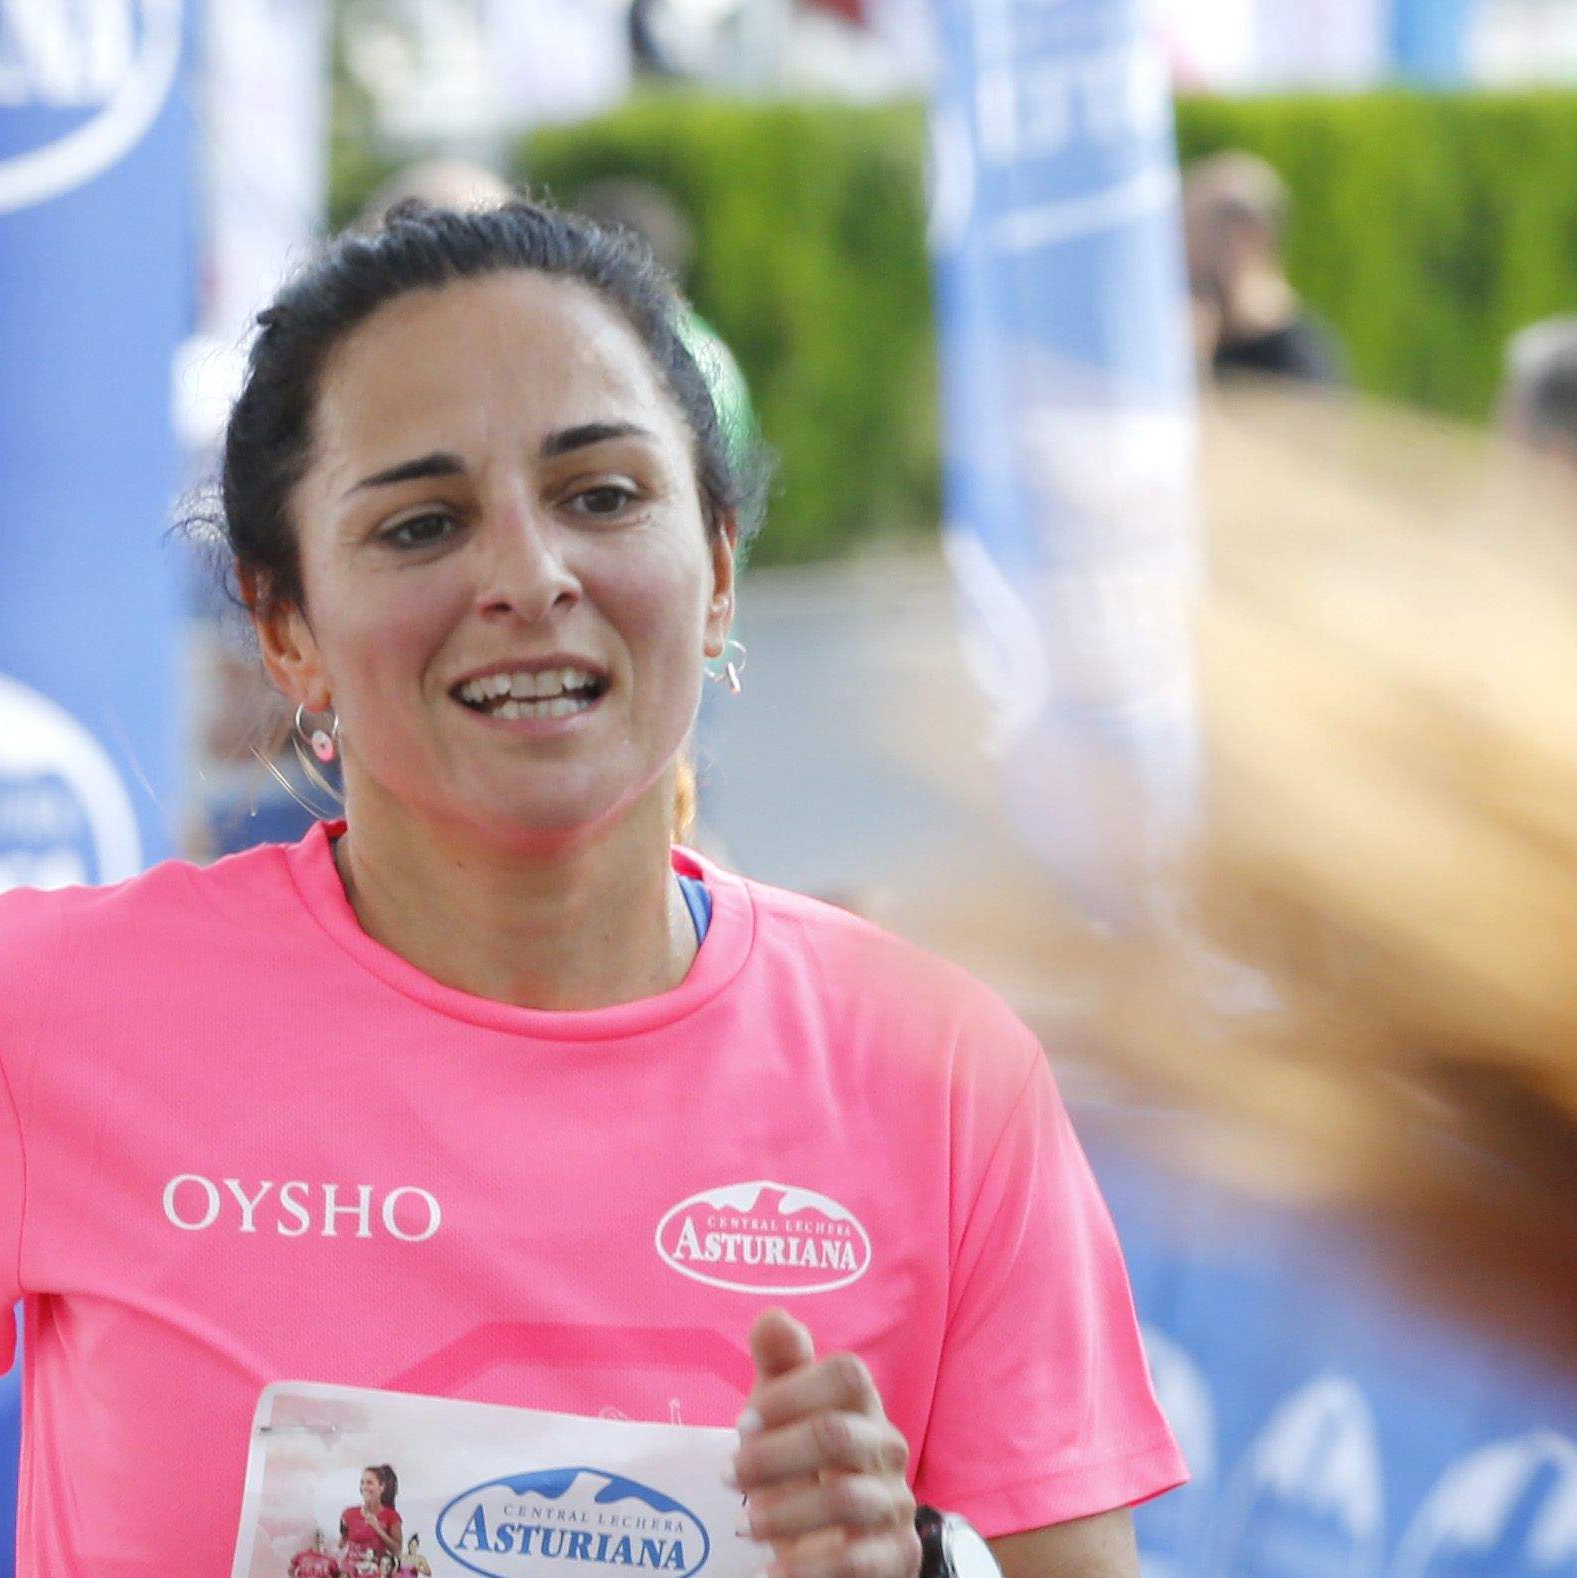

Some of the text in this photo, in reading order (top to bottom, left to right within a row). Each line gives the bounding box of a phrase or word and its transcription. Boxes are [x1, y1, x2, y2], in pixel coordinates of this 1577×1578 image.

[162, 1174, 442, 1242] OYSHO
[504, 1503, 685, 1534] CENTRAL LECHERA
